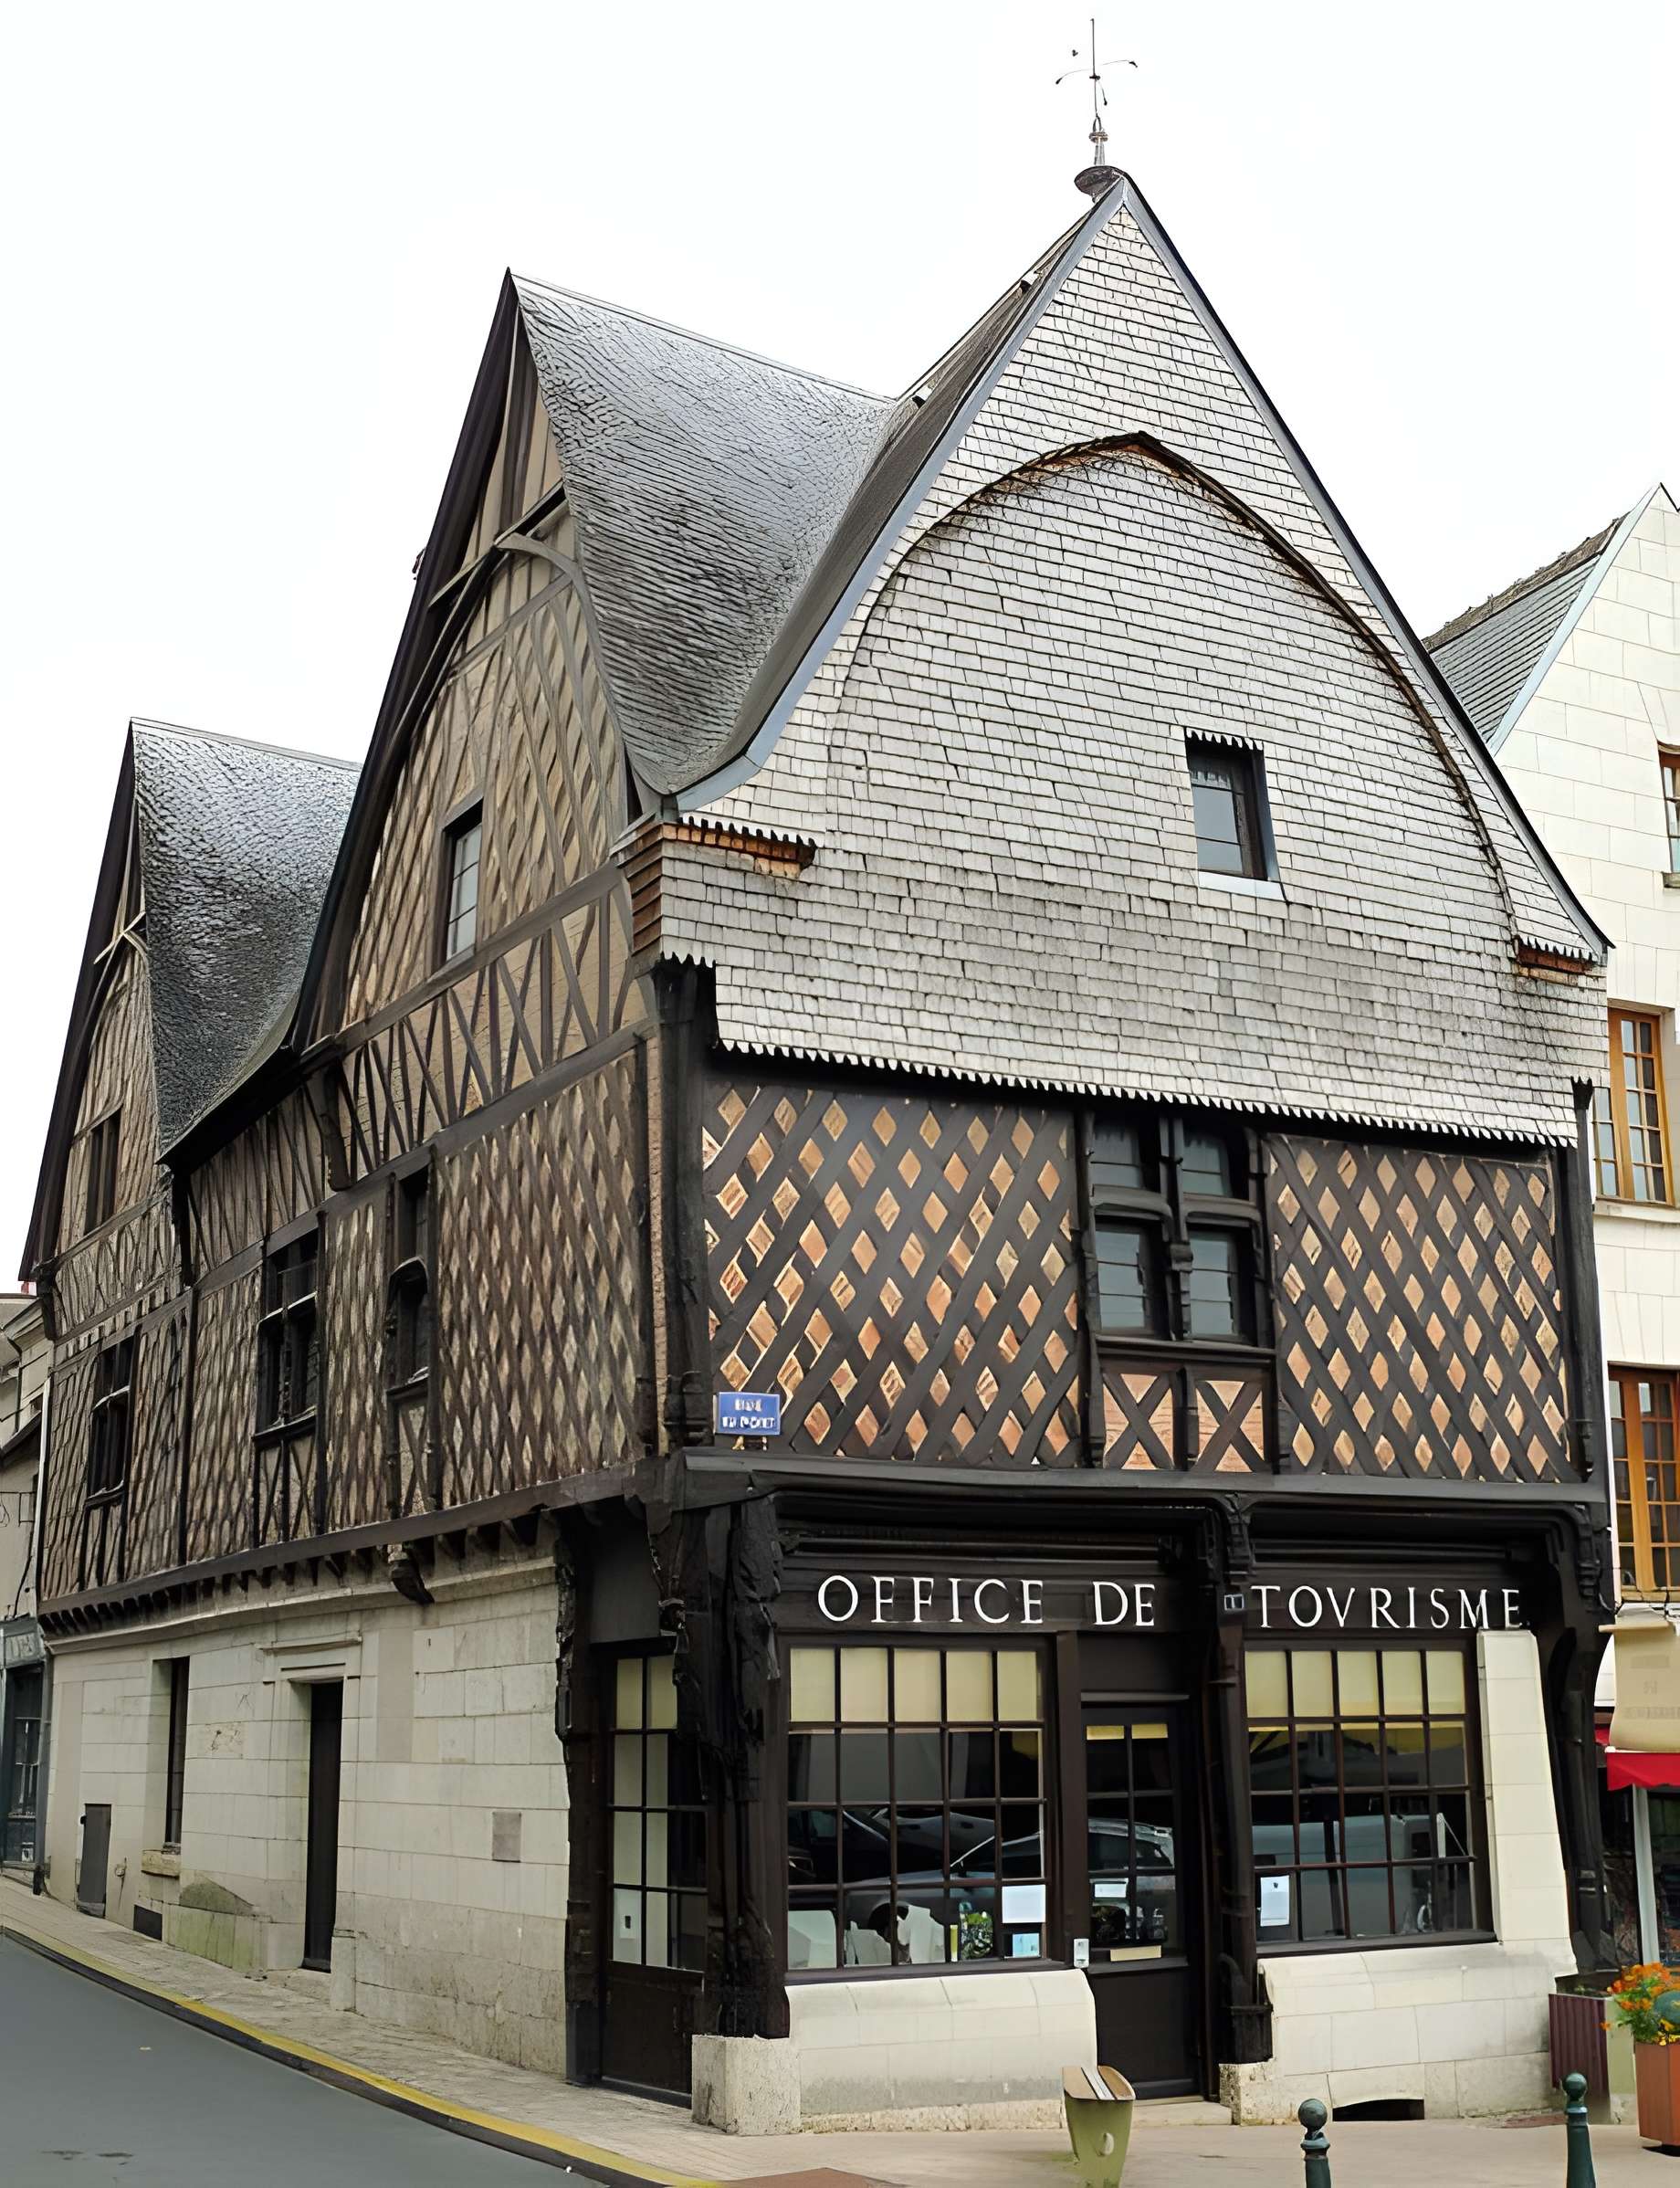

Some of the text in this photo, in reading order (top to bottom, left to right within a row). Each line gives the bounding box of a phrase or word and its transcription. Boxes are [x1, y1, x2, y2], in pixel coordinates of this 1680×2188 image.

[817, 1574, 1523, 1629] OFFICE DE TOVRISME
